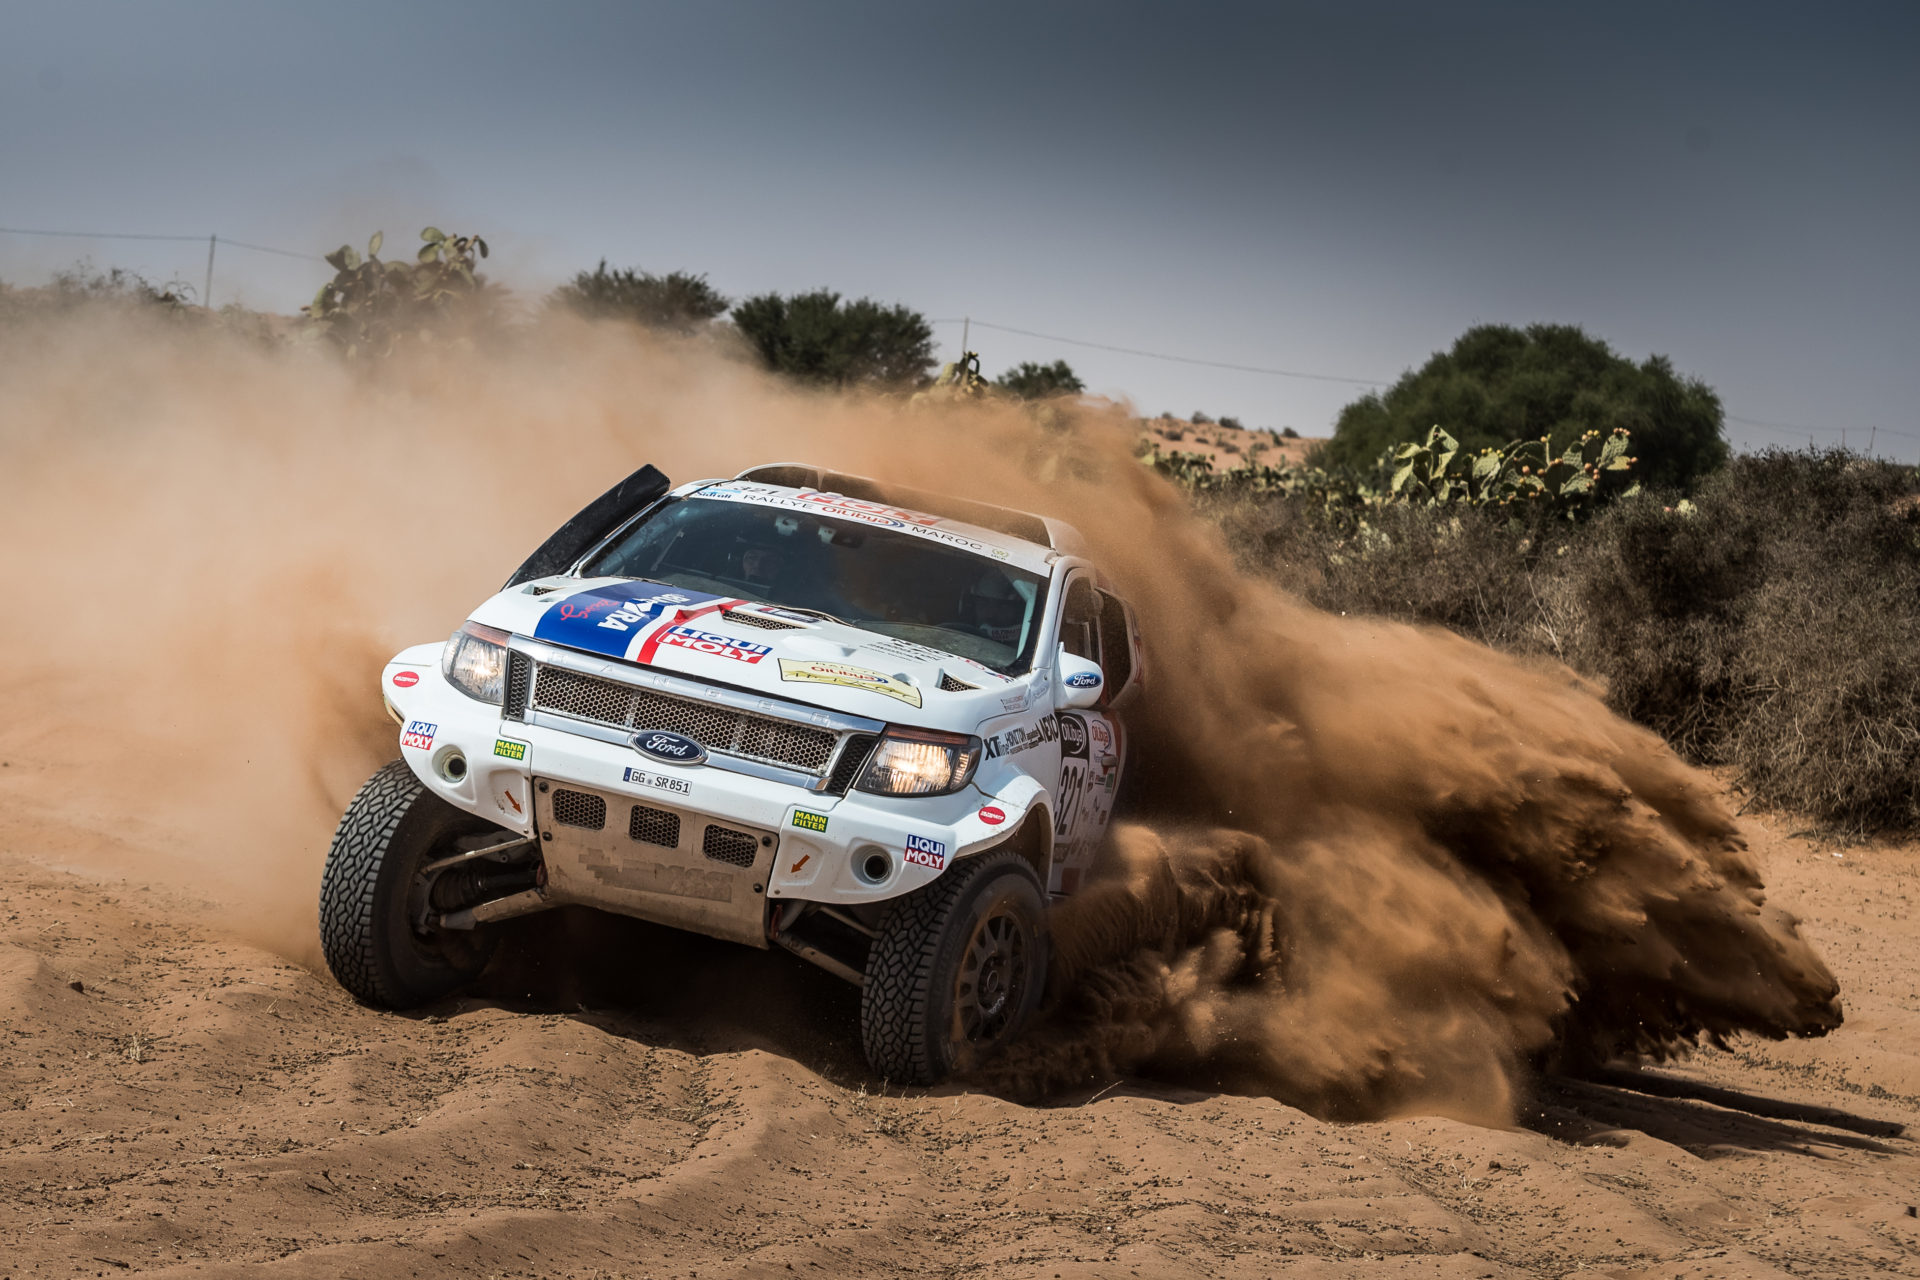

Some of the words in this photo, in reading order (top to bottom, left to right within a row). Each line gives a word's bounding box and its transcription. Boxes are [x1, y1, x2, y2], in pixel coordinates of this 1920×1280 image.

[743, 494, 813, 510] RALLYE
[910, 525, 983, 551] MAROC
[672, 626, 771, 655] LIQUI
[664, 635, 764, 664] MOLY
[1072, 674, 1097, 686] Ford
[408, 721, 437, 737] LIQUI
[403, 733, 433, 750] MOLY
[496, 740, 525, 752] MANN
[645, 733, 689, 757] Ford
[495, 747, 523, 759] FILTER
[631, 770, 646, 784] GG
[1054, 765, 1086, 836] 321
[793, 818, 826, 832] FILTER
[795, 811, 827, 824] MANN
[908, 835, 945, 857] LIQUI
[905, 849, 944, 870] MOLY
